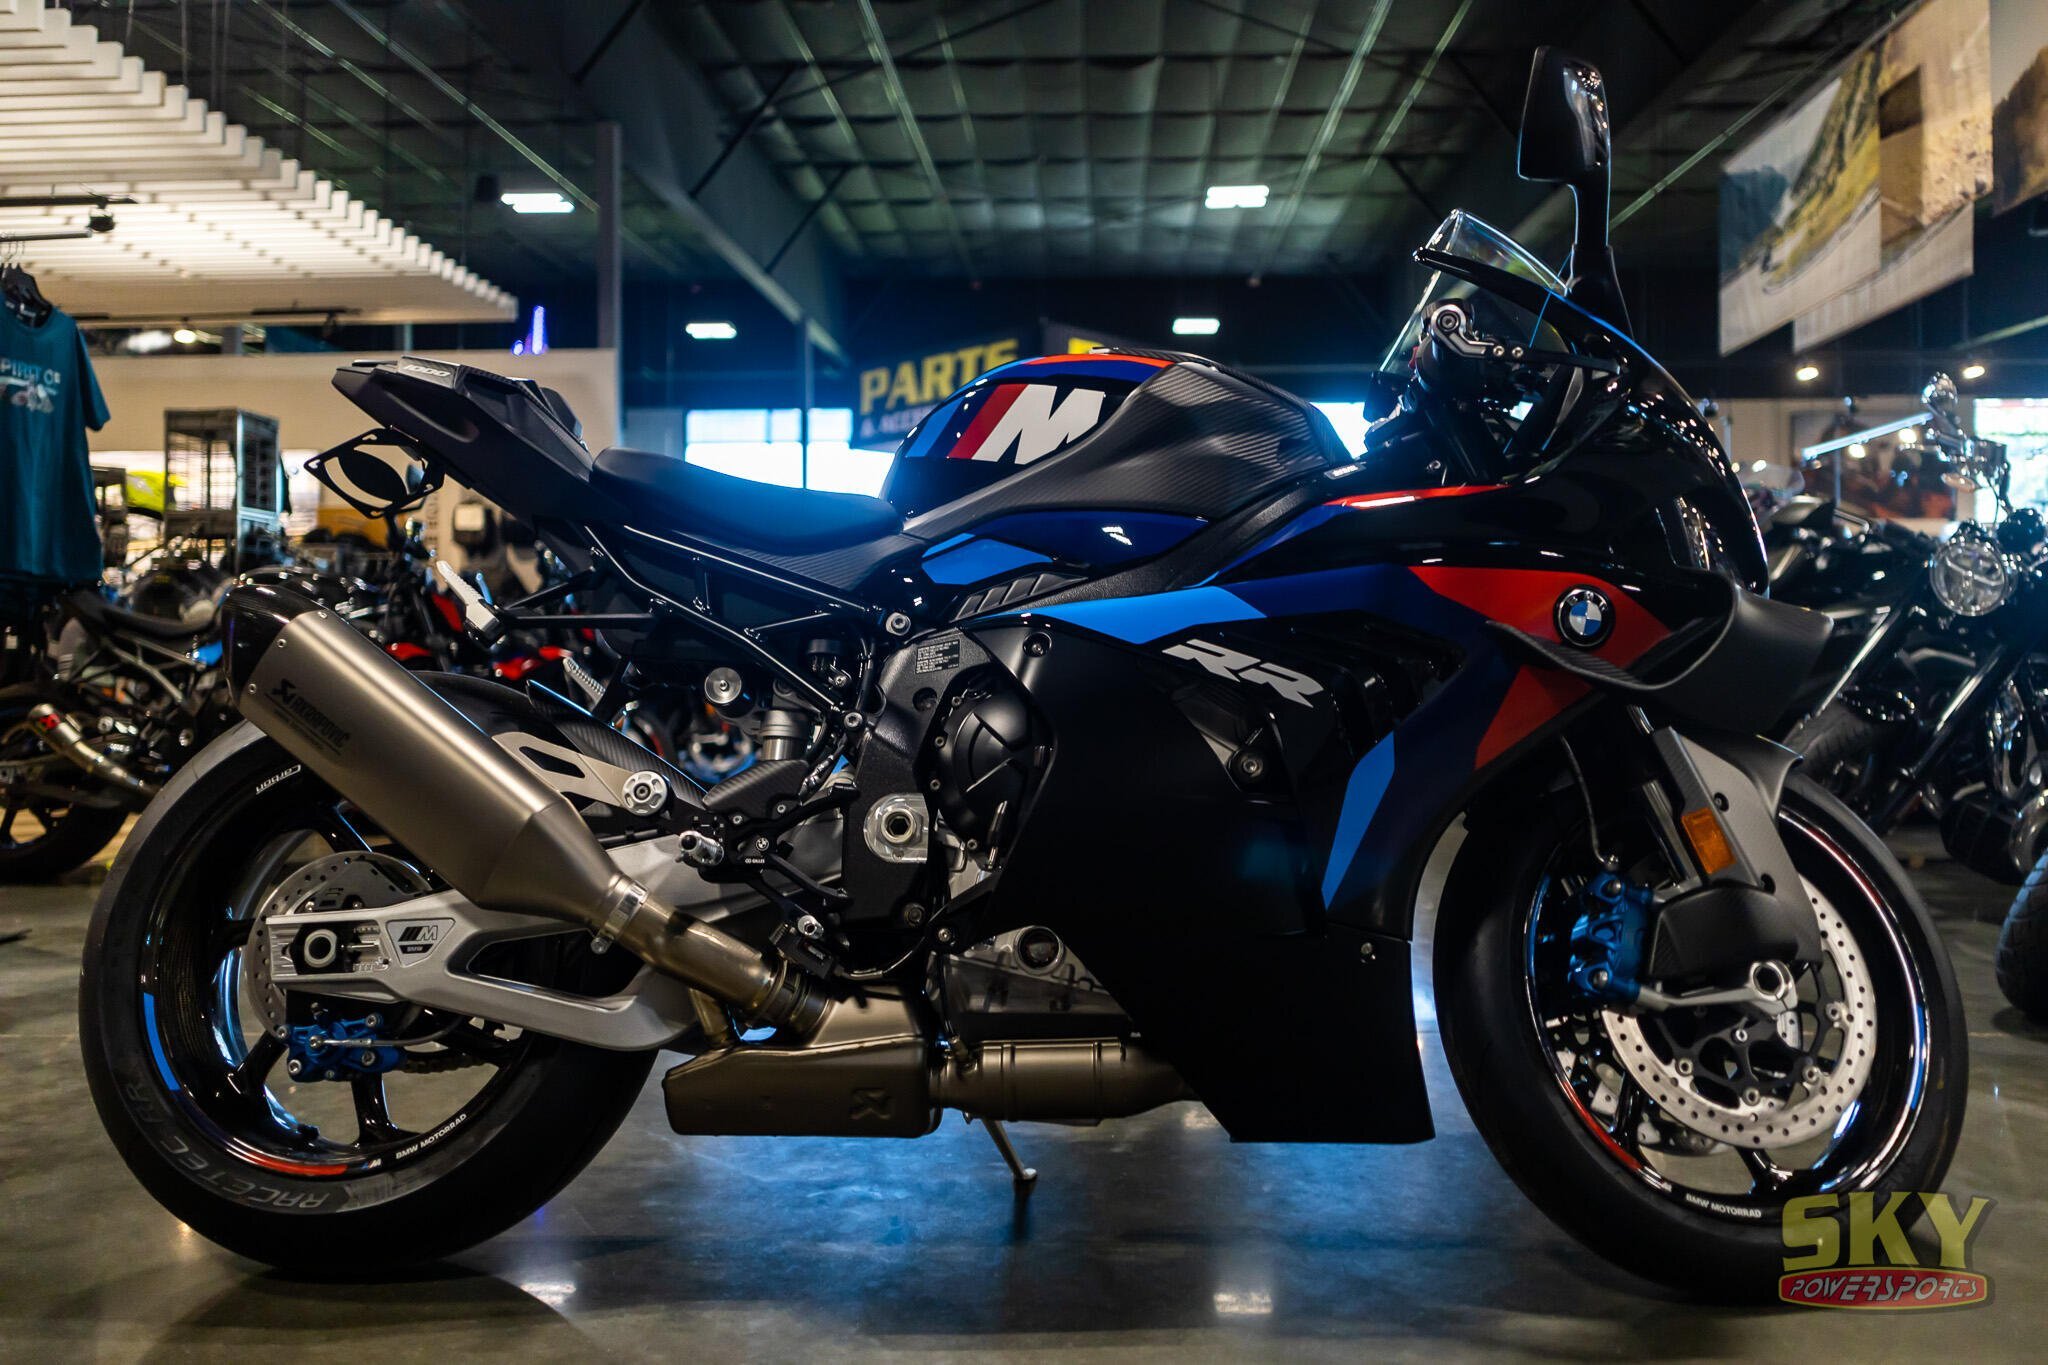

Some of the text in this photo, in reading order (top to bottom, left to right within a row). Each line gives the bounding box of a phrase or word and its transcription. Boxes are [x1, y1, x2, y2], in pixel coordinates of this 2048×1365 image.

[971, 383, 1106, 466] M
[1161, 638, 1325, 709] RR
[255, 764, 302, 796] Carbon
[395, 1144, 419, 1160] BMW
[420, 1113, 468, 1149] MOTORRAD
[160, 1135, 332, 1209] RACETEC
[1685, 1193, 1763, 1219] BMW MOTORRAD
